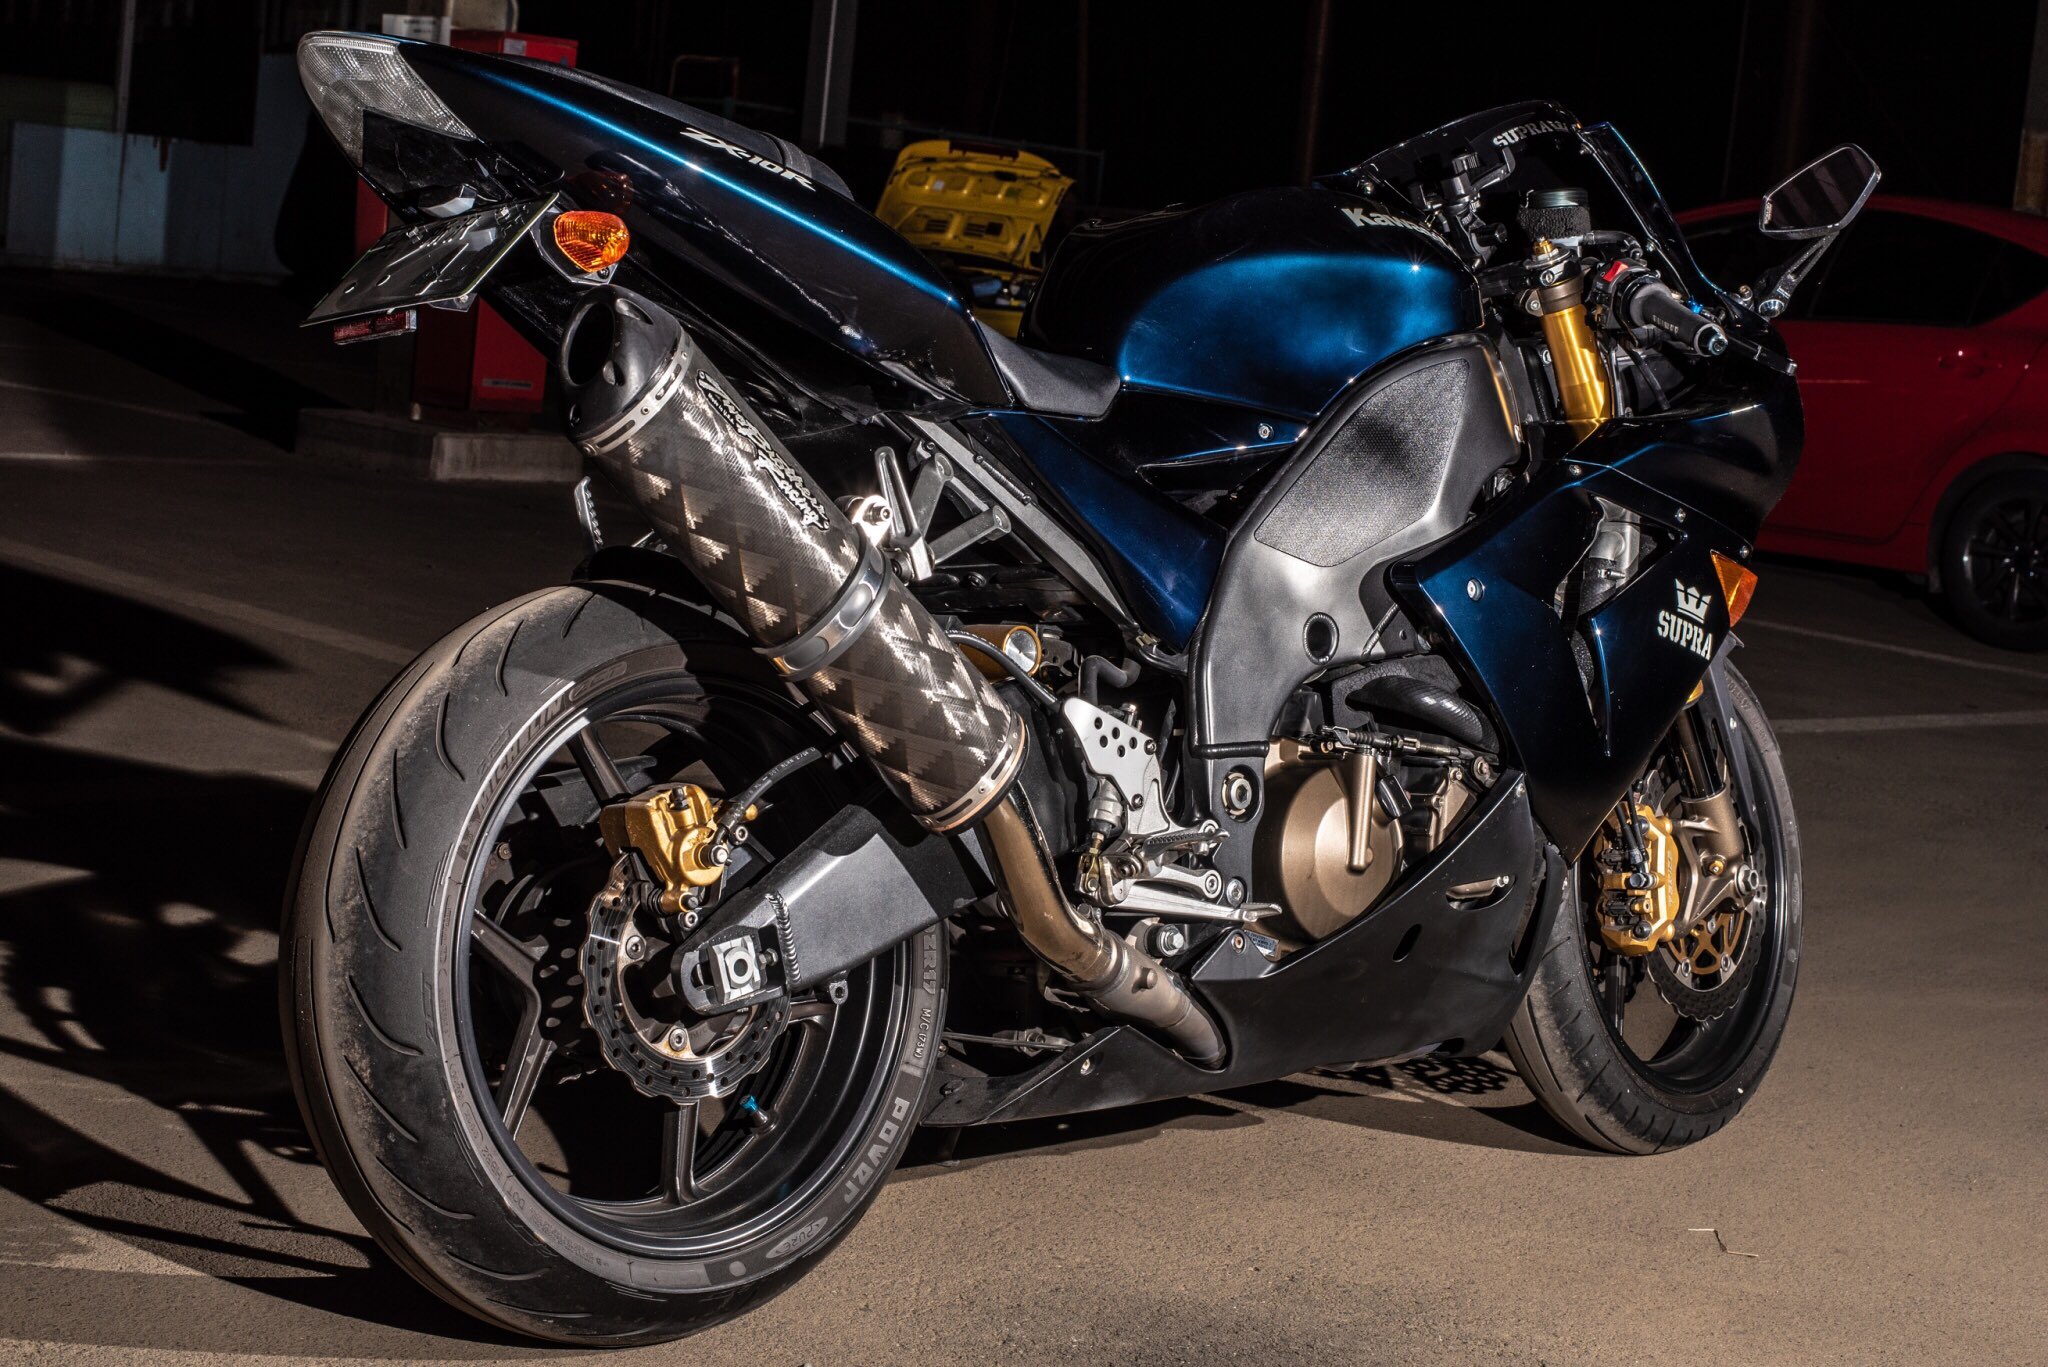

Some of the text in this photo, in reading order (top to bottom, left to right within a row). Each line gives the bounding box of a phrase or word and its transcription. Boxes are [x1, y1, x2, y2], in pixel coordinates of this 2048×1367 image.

[679, 127, 816, 192] ZX-10R
[698, 372, 748, 427] Two
[1657, 610, 1712, 660] SUPRA
[474, 694, 564, 818] MICHELIN
[919, 1008, 932, 1031] M/C
[914, 1033, 927, 1058] (73W)
[783, 1222, 817, 1251] PURE
